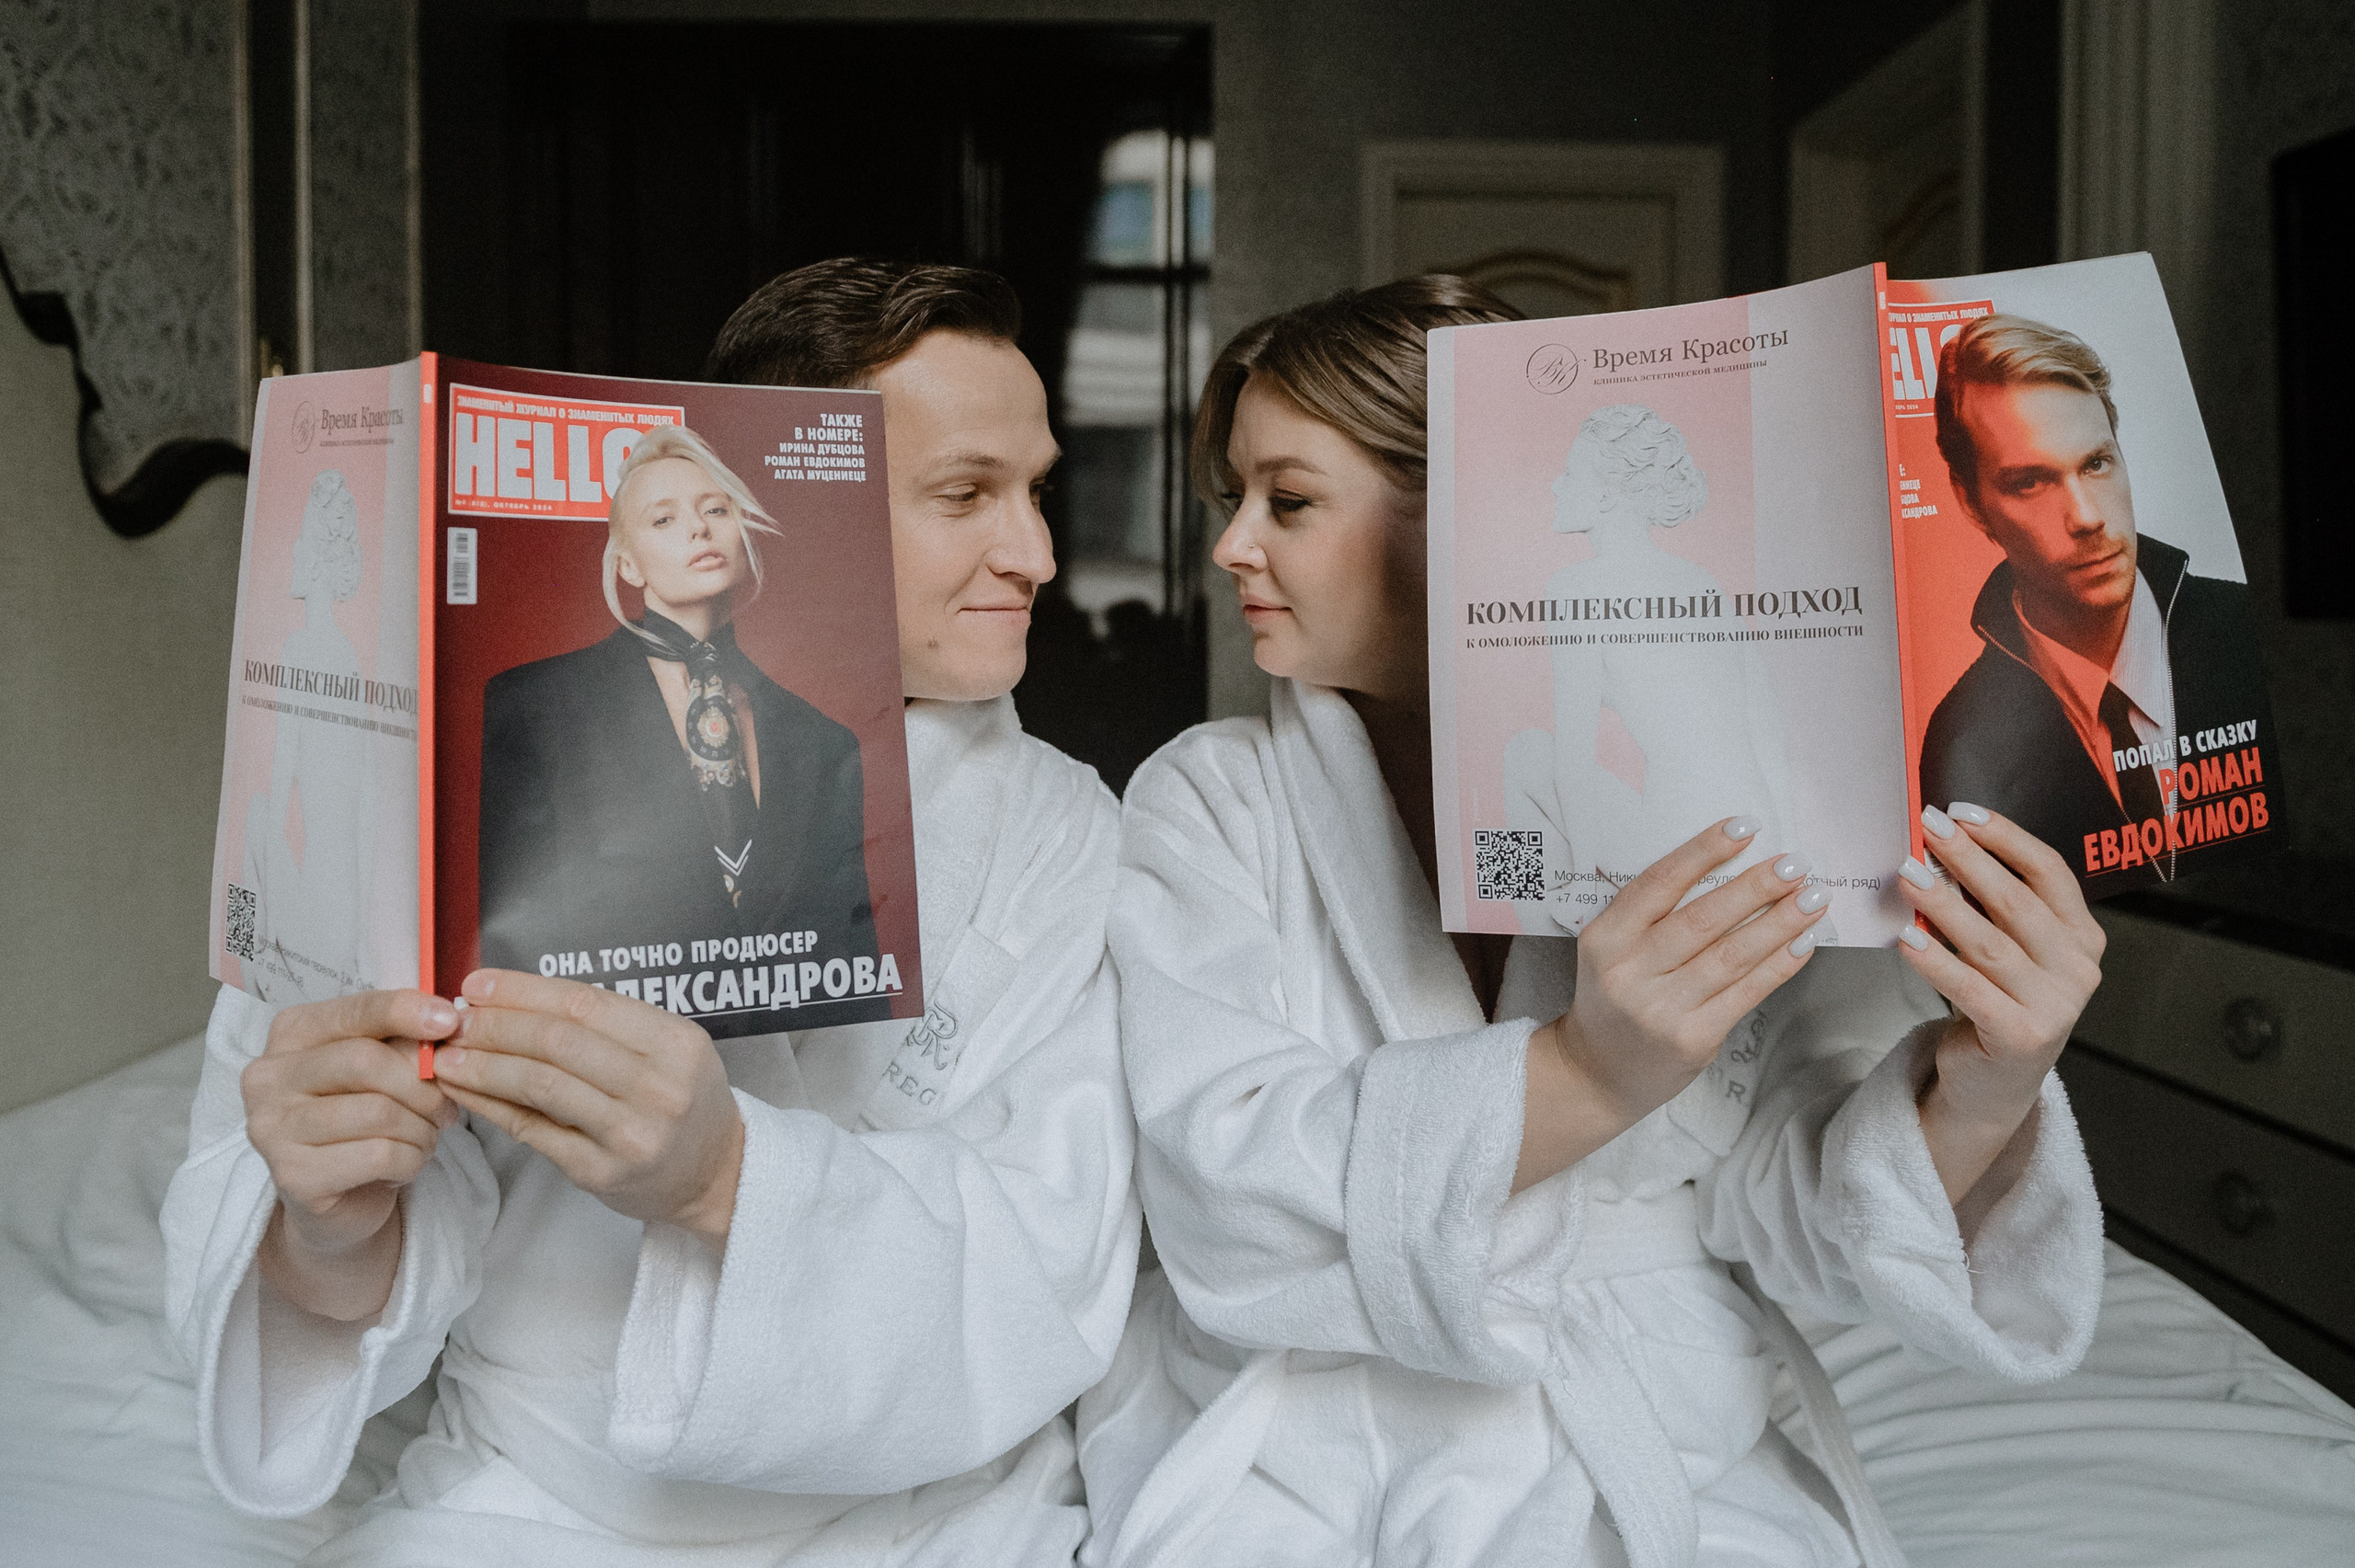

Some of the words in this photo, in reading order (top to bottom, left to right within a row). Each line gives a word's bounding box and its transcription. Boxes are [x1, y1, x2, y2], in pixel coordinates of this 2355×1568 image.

[1959, 306, 1989, 319] ЛЮДЯХ
[1592, 347, 1672, 372] Время
[1682, 329, 1788, 363] Красоты
[1593, 375, 1638, 385] КЛИНИКА
[1640, 367, 1711, 382] ЭСТЕТИЧЕСКОЙ
[1713, 360, 1767, 374] МЕДИЦИНЫ
[321, 408, 357, 435] Время
[361, 406, 404, 434] Красоты
[516, 403, 557, 418] ЖУРНАЛ
[557, 406, 566, 419] О
[568, 408, 635, 424] ЗНАМЕНИТЫХ
[637, 414, 675, 427] ЛЮДЯХ
[820, 413, 863, 428] ТАКЖЕ
[794, 427, 803, 441] В
[807, 427, 864, 441] НОМЕРЕ:
[779, 442, 815, 453] ИРИНА
[817, 443, 865, 456] ДУБЦОВА
[764, 455, 800, 466] РОМАН
[803, 456, 866, 468] ЕВДОКИМОВ
[774, 469, 805, 480] АГАТА
[807, 470, 867, 483] МУЦЕНИЕЦЕ
[1466, 589, 1722, 624] КОМПЛЕКСНЫЙ
[1734, 586, 1863, 620] ПОДХОД
[1466, 638, 1476, 648] К
[1478, 634, 1583, 648] ОМОЛОЖЕНИЮ
[1587, 634, 1596, 645] И
[1601, 629, 1770, 645] СОВЕРШЕНСТВОВАНИЮ
[1775, 624, 1864, 641] ВНЕШНОСТИ
[244, 659, 360, 702] КОМПЛЕКСНЫЙ
[2112, 738, 2175, 773] ПОПАЛ
[2179, 735, 2192, 757] В
[2195, 719, 2257, 753] СКАЗКУ
[2159, 746, 2263, 806] РОМАН
[2083, 791, 2269, 873] ЕВДОКИМОВ
[1555, 870, 1605, 883] Москва,
[1852, 876, 1881, 890] ряд)
[1556, 892, 1571, 903] +7
[1575, 893, 1598, 905] 499
[539, 950, 593, 977] ОНА
[600, 942, 683, 972] ТОЧНО
[691, 931, 819, 964] ПРОДЮСЕР
[591, 954, 903, 1014] ЕКСАНДРОВА
